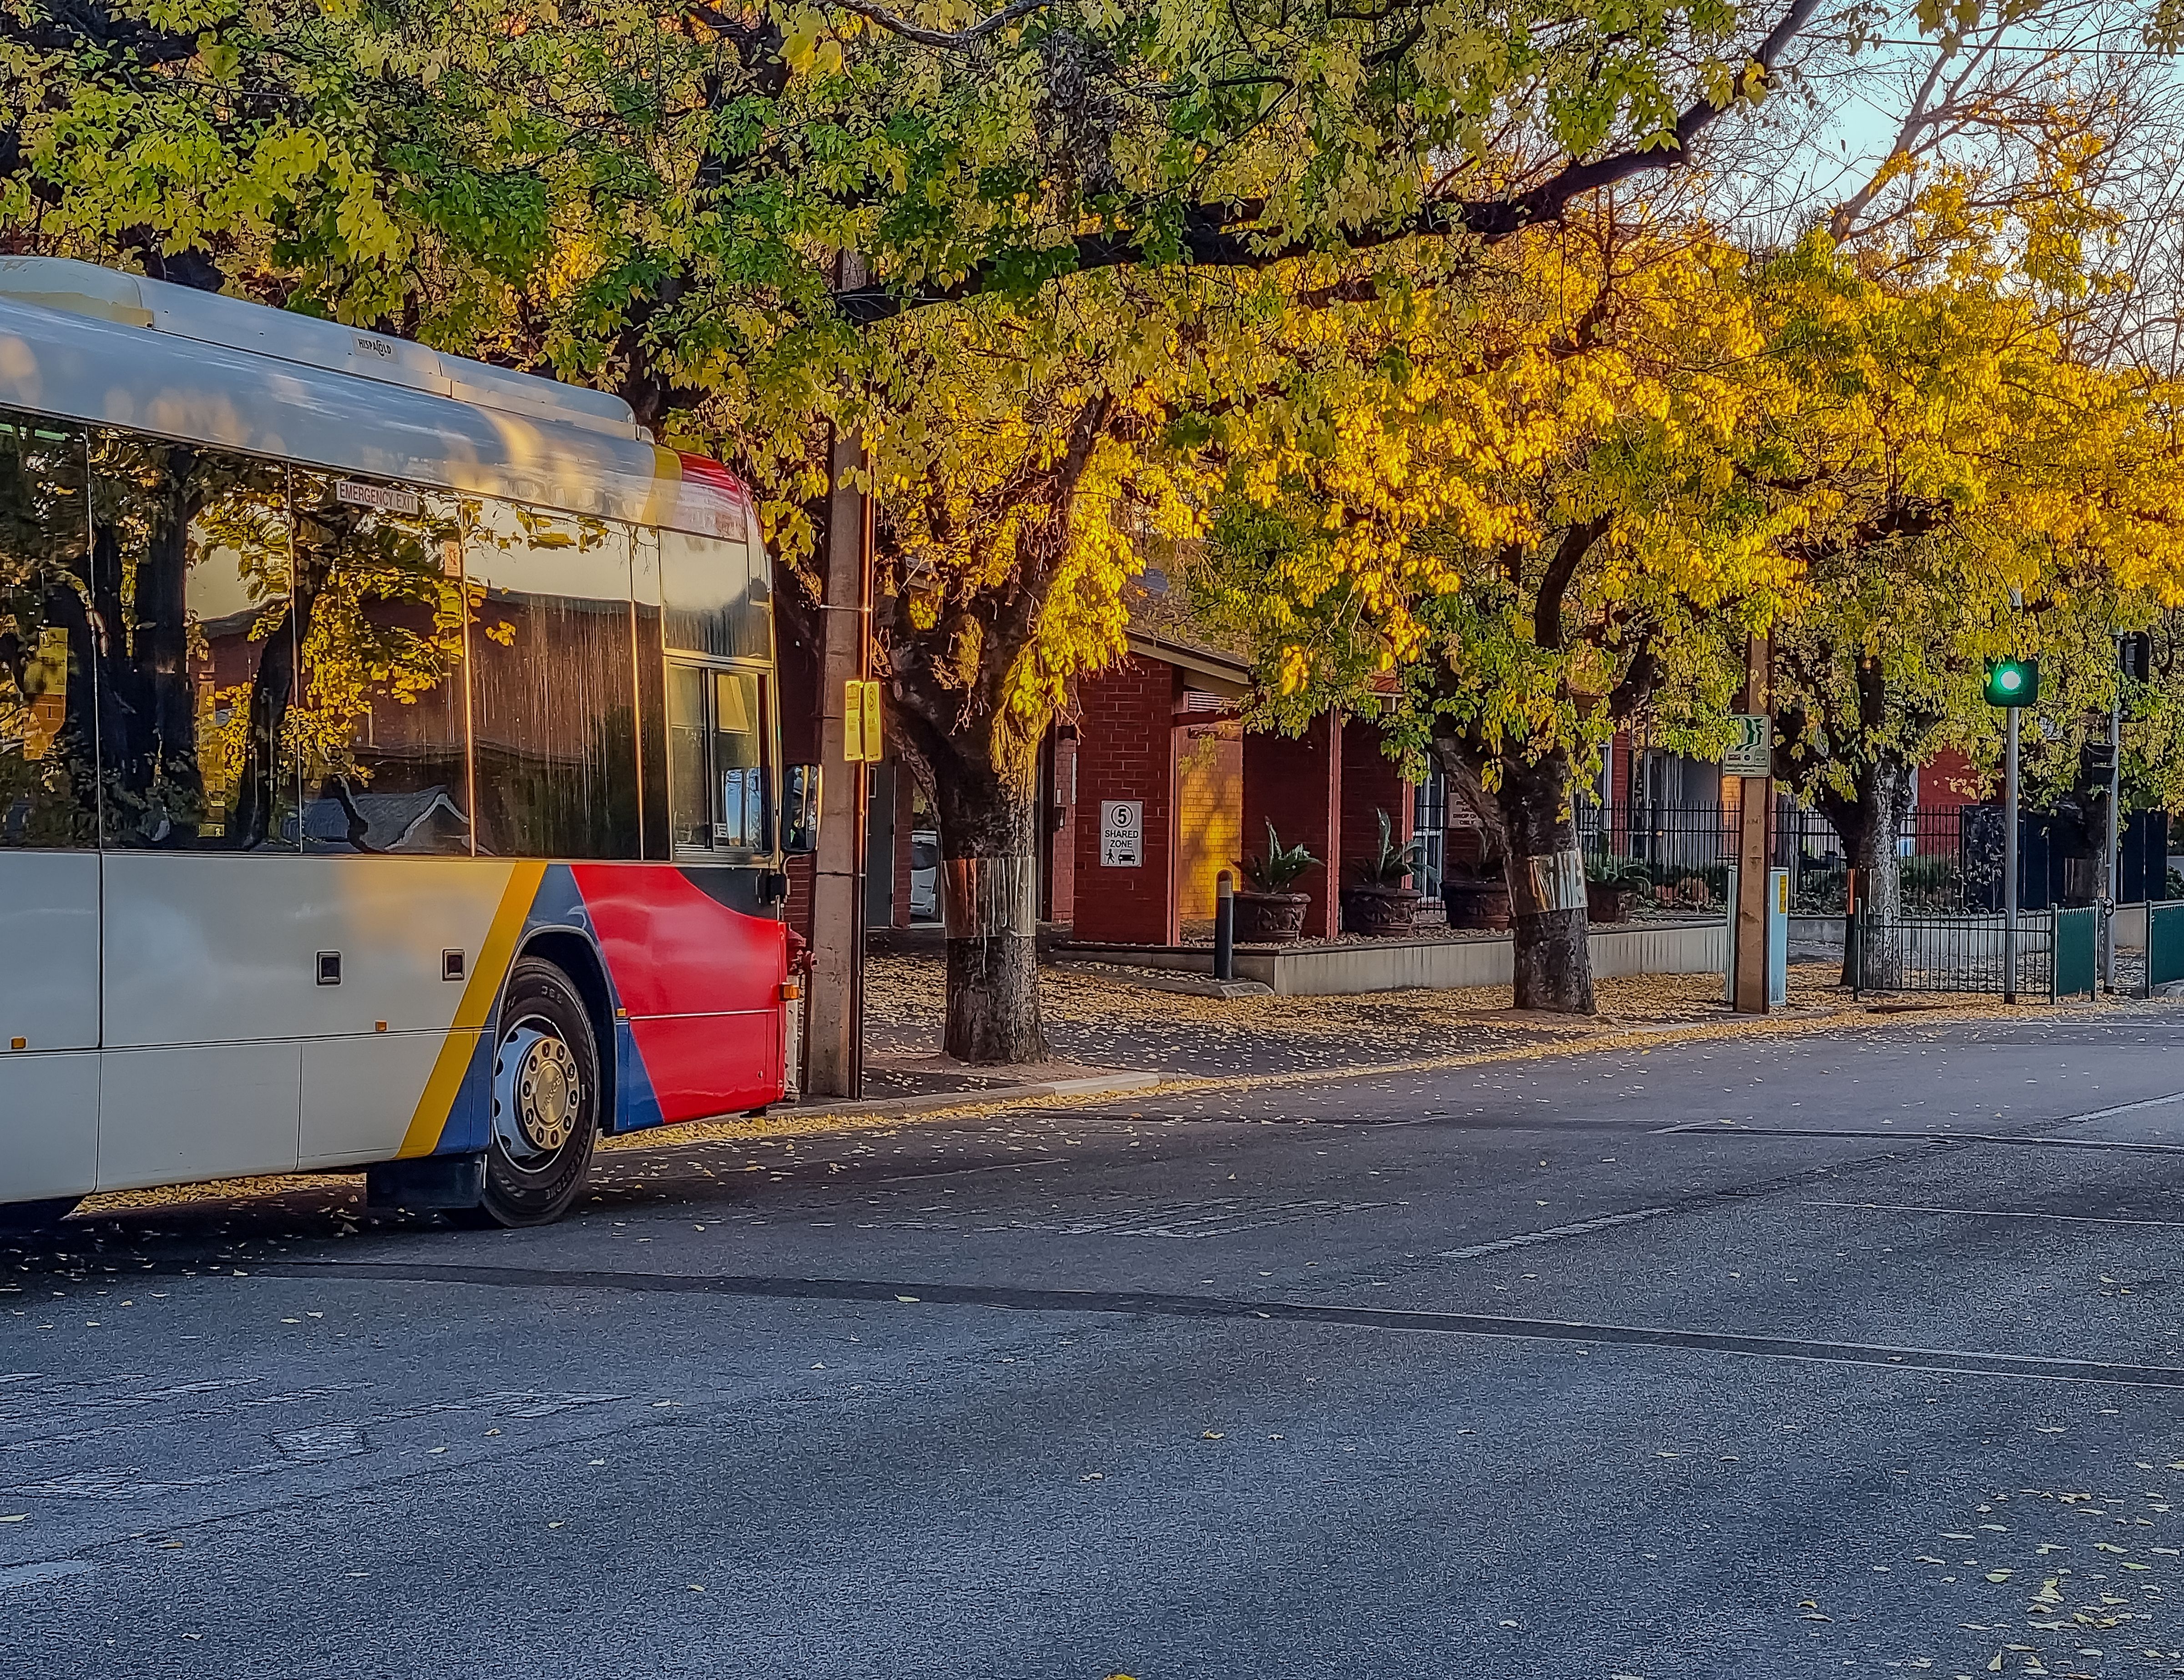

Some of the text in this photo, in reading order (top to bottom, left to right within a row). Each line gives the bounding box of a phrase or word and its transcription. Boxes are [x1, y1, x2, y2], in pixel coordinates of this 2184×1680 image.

[358, 338, 391, 357] HISPACOLD
[340, 484, 415, 510] EMERGENCY EXIT
[1117, 808, 1127, 824] 5
[1105, 830, 1139, 838] SHARED
[1110, 840, 1132, 848] ZONE
